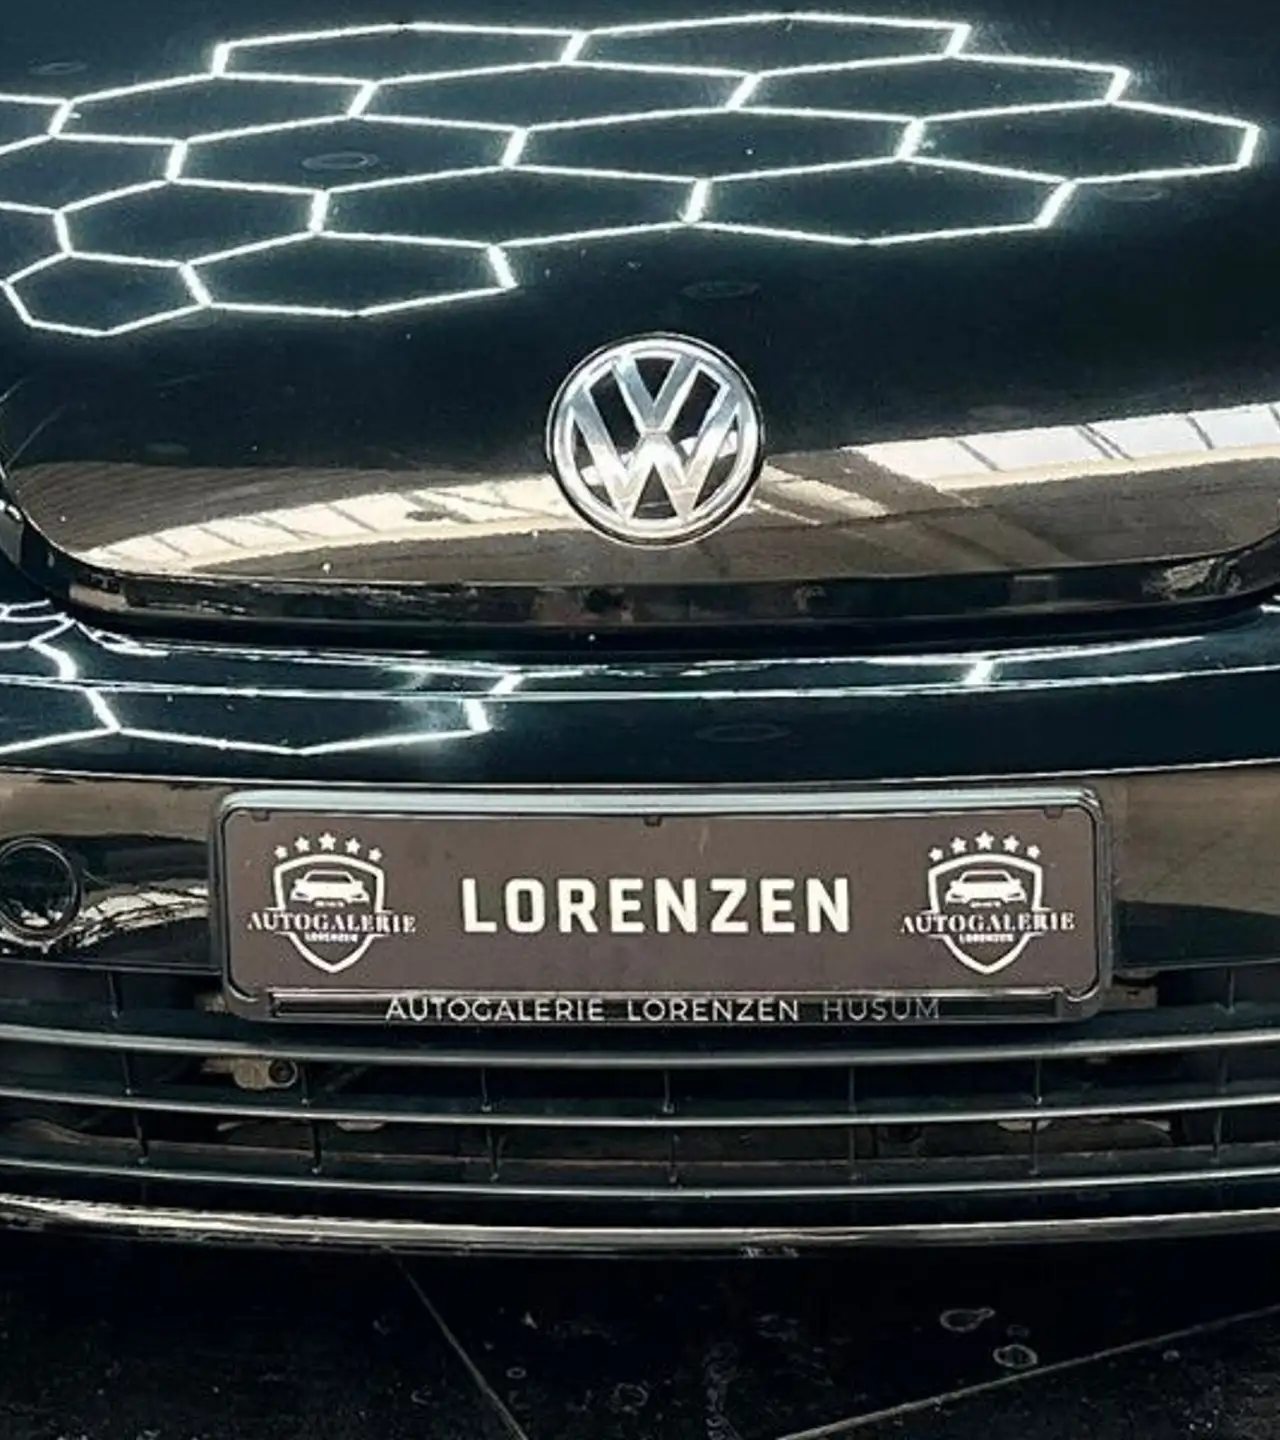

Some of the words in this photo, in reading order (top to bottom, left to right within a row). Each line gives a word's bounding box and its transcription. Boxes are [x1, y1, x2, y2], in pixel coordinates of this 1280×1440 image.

[461, 877, 850, 934] LORENZEN
[247, 912, 417, 934] AUTOGALERIE
[900, 912, 1075, 934] AUTOGALERIE
[385, 997, 605, 1022] AUTOGALERIE
[627, 997, 799, 1022] LORENZEN
[823, 998, 939, 1021] HUSUM
